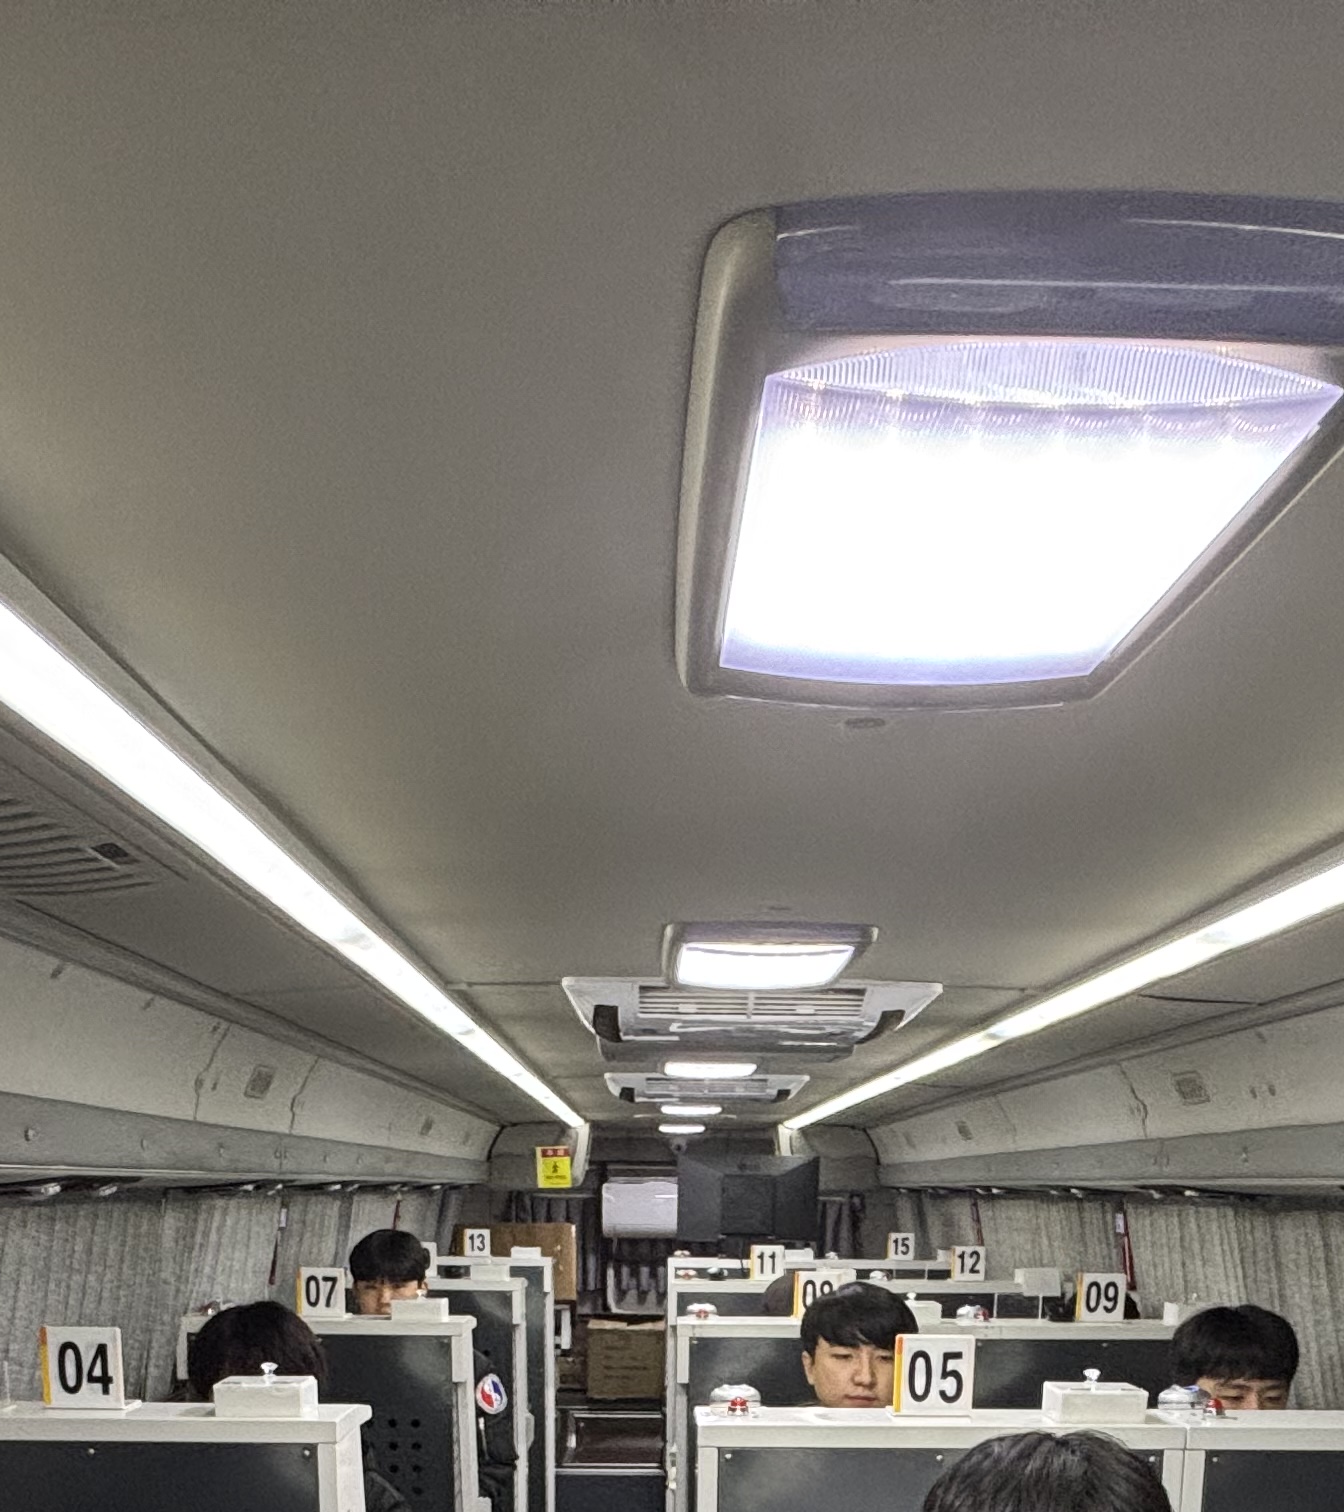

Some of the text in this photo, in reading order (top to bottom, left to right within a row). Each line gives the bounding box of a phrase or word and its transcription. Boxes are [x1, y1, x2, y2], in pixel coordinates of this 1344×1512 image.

[469, 1234, 485, 1251] 13
[892, 1237, 910, 1256] 15
[757, 1252, 777, 1275] 11
[958, 1251, 981, 1275] 12
[305, 1275, 337, 1308] 07
[1085, 1281, 1119, 1314] 09
[58, 1342, 113, 1395] 04
[908, 1350, 964, 1404] 05
